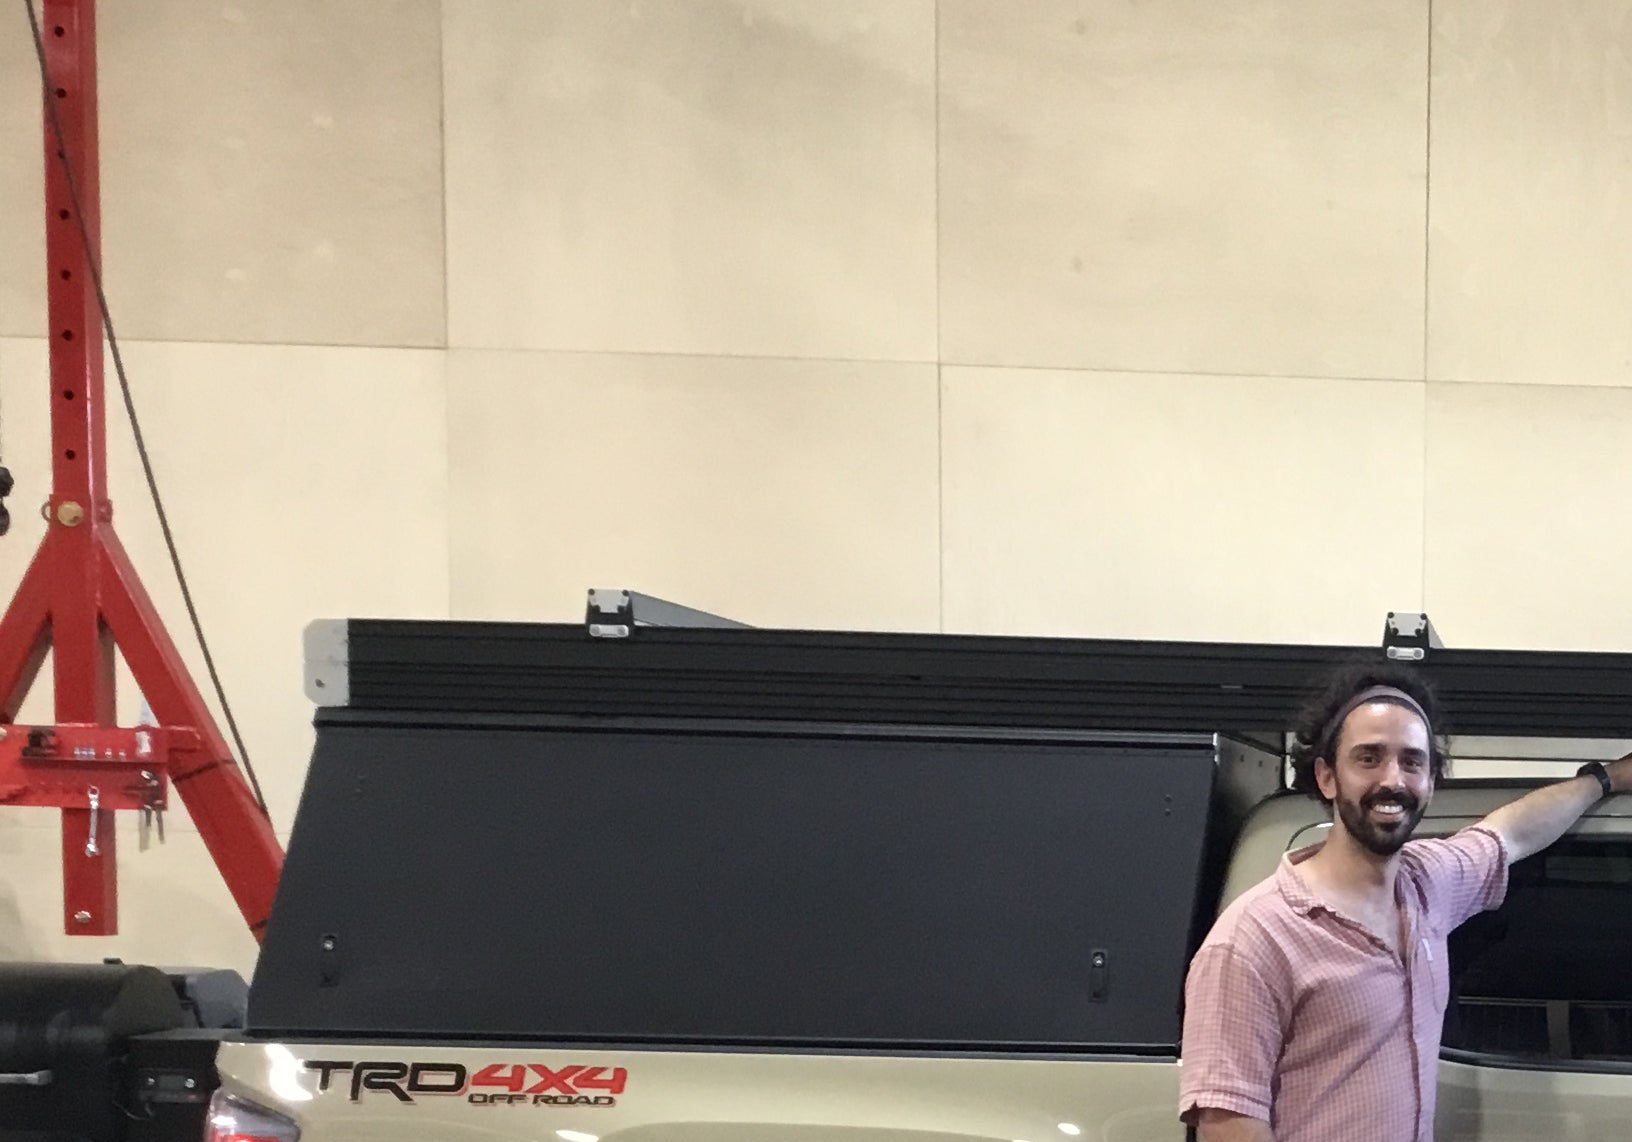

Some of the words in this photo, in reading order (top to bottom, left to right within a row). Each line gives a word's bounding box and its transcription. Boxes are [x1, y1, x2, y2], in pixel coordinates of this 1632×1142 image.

[303, 1060, 468, 1103] TRD
[468, 1094, 527, 1105] OFF
[532, 1095, 616, 1106] ROAD
